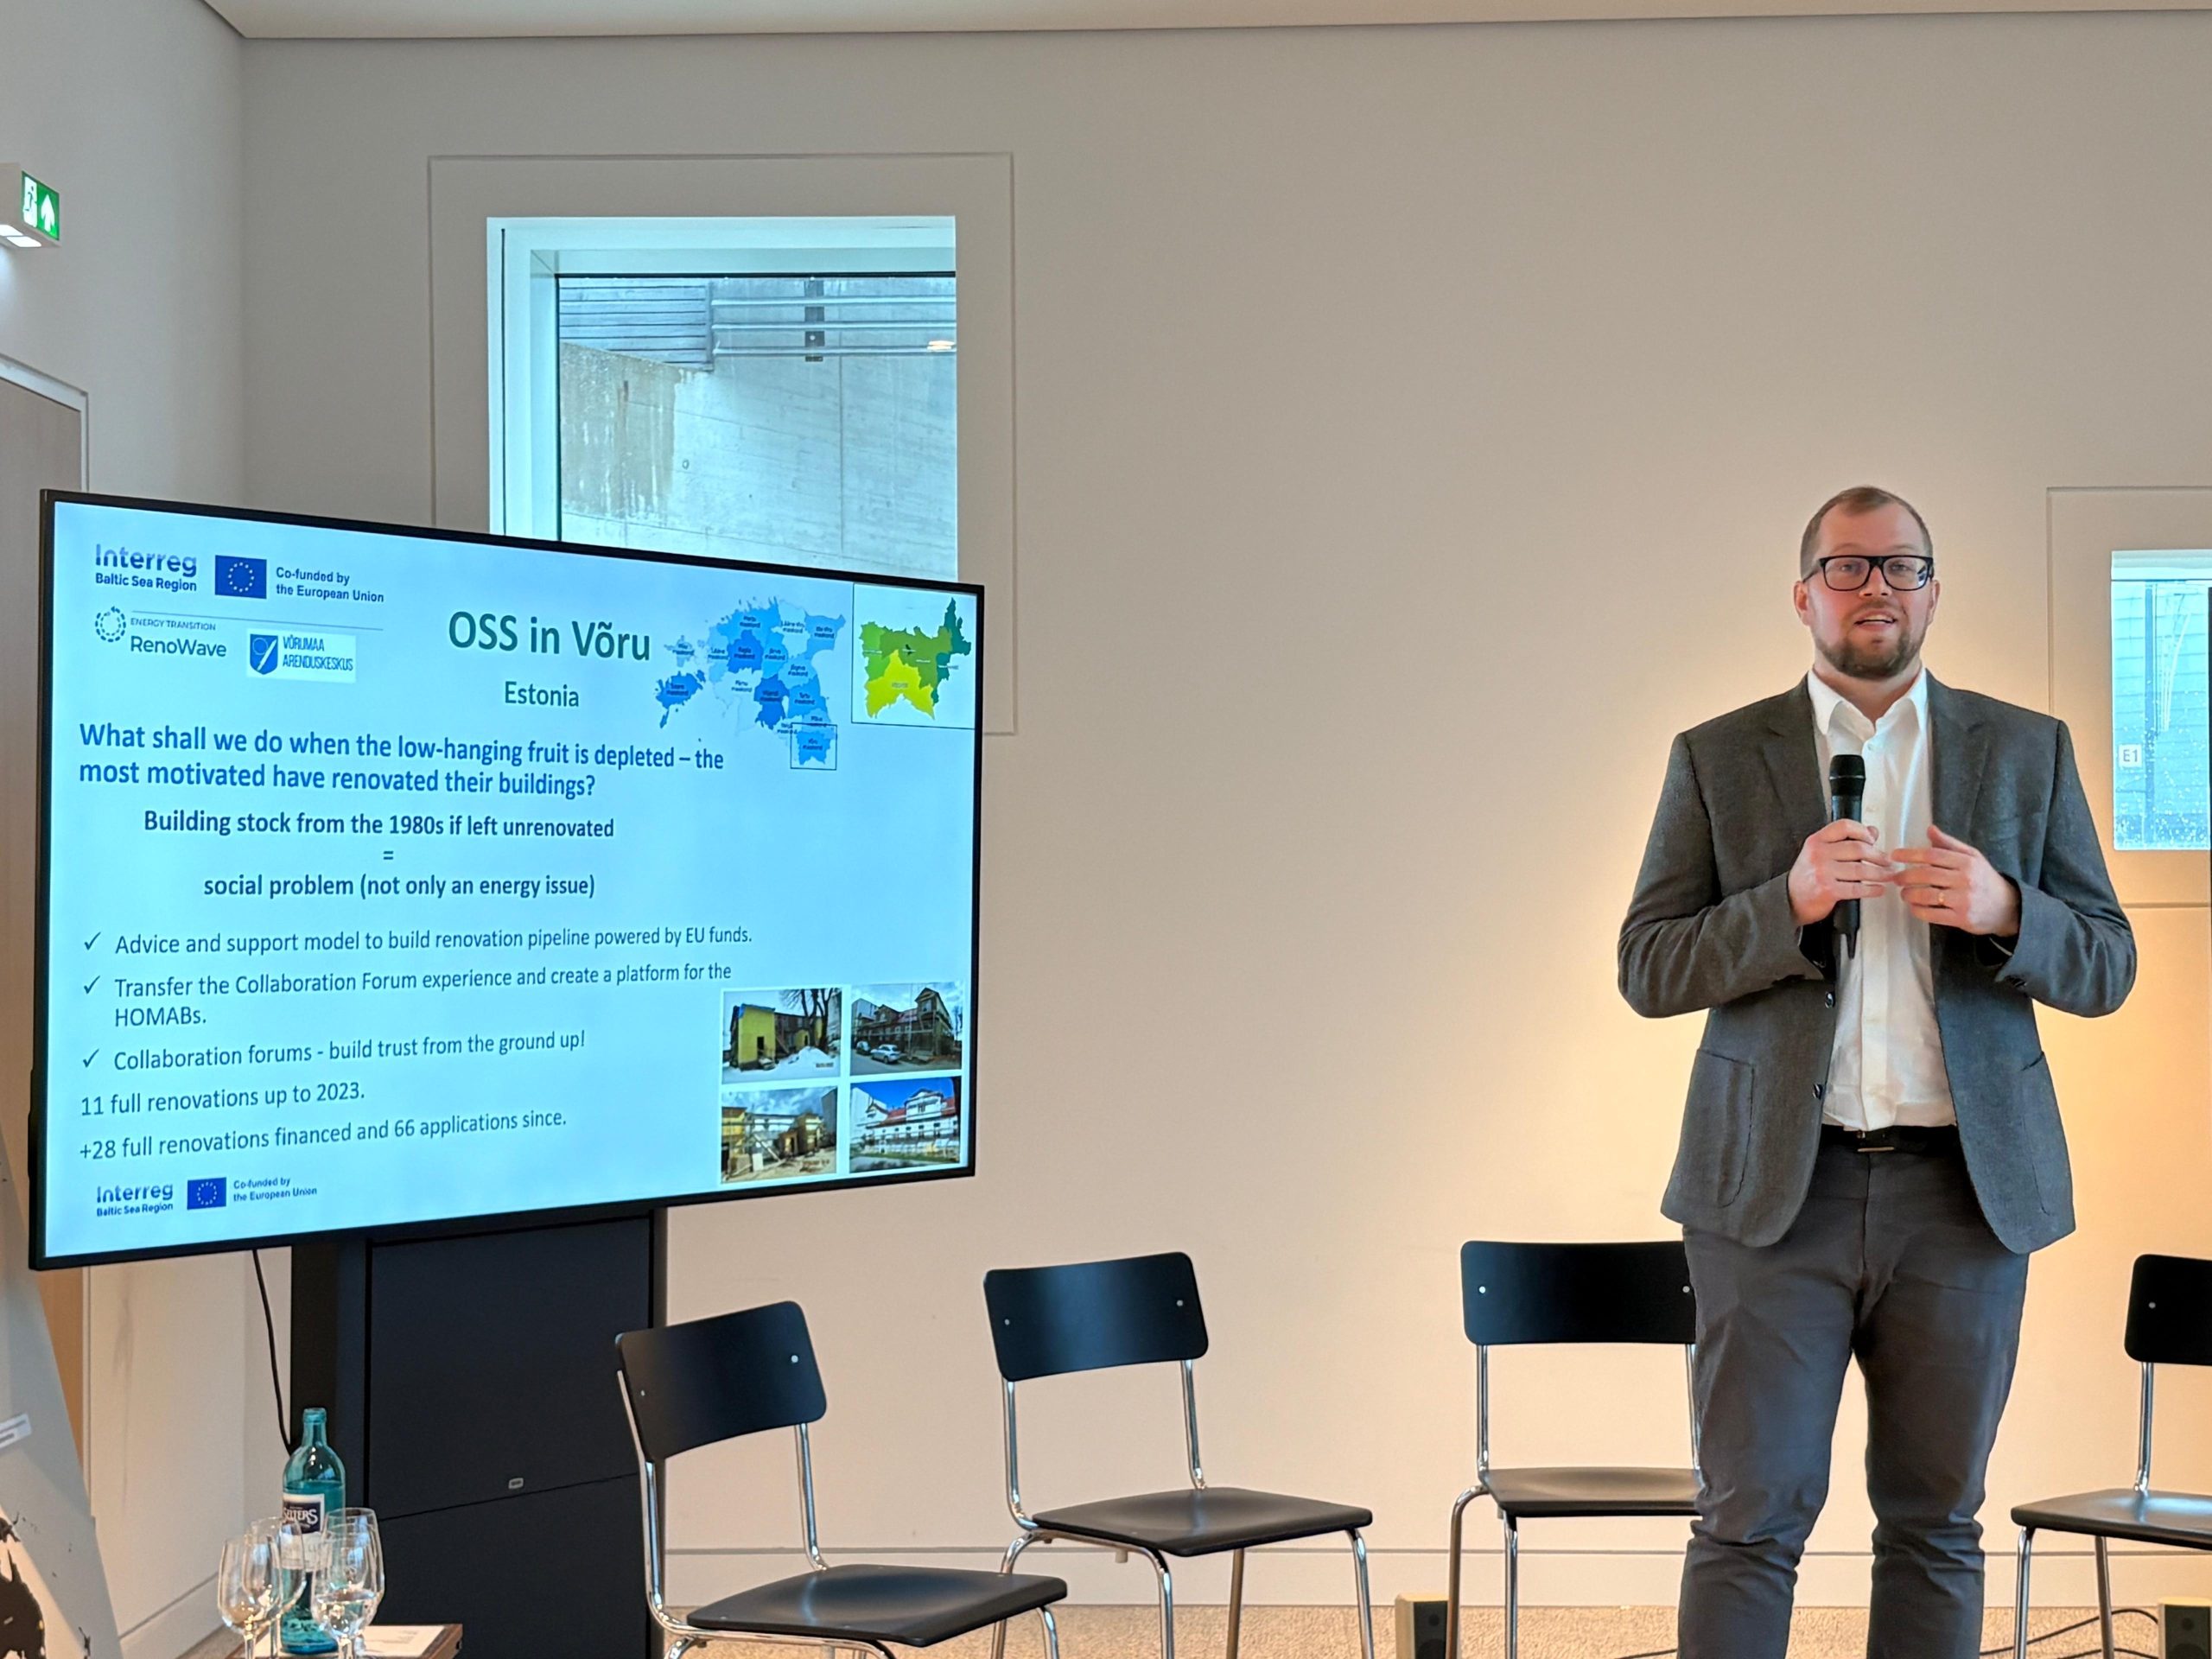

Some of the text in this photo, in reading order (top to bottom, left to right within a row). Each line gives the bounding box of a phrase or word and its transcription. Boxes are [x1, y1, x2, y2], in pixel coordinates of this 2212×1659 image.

[96, 544, 197, 576] Interreg
[96, 573, 196, 592] Baltic Sea Region
[276, 567, 349, 586] Co-funded by
[276, 584, 384, 602] the European Union
[130, 618, 215, 630] ENERGY TRANSITION
[131, 636, 226, 657] RenoWave
[449, 612, 649, 660] OSS in Võru
[283, 654, 353, 671] ARENDUSKESKUS
[505, 681, 579, 707] Estonia
[79, 722, 145, 747] What
[153, 725, 206, 749] shall
[213, 734, 246, 751] we
[255, 729, 282, 753] do
[289, 732, 349, 754] when
[356, 734, 391, 757] the
[399, 735, 522, 766] low-hanging
[528, 741, 569, 763] fruit
[575, 743, 588, 764] is
[594, 744, 674, 770] depleted
[695, 748, 723, 769] the
[2123, 749, 2138, 762] E1
[80, 762, 594, 800] most motivated have renovated their buildings?
[145, 810, 613, 836] Building stock from the 1980s if left unrenovated
[384, 851, 393, 860] =
[204, 874, 594, 899] social problem (not only an energy issue)
[115, 926, 752, 956] Advice and support model to build renovation pipeline powered by EU funds.
[115, 963, 731, 997] Transfer the Collaboration Forum experience and create a platform for the
[116, 1007, 206, 1027] HOMABs.
[115, 1046, 241, 1070] Collaboration
[249, 1045, 311, 1064] forums
[330, 1039, 372, 1059] build
[378, 1039, 417, 1057] trust
[423, 1037, 461, 1054] from
[467, 1034, 494, 1052] the
[499, 1031, 555, 1055] ground
[561, 1030, 584, 1051] up!
[82, 1082, 364, 1116] 11 full renovations up to 2023.
[80, 1110, 566, 1160] +28 full renovations financed and 66 applications since.
[97, 1185, 173, 1203] Interreg
[233, 1178, 290, 1189] Co-funded by
[233, 1188, 317, 1202] the European Union
[97, 1203, 173, 1217] Baltic Sea Region
